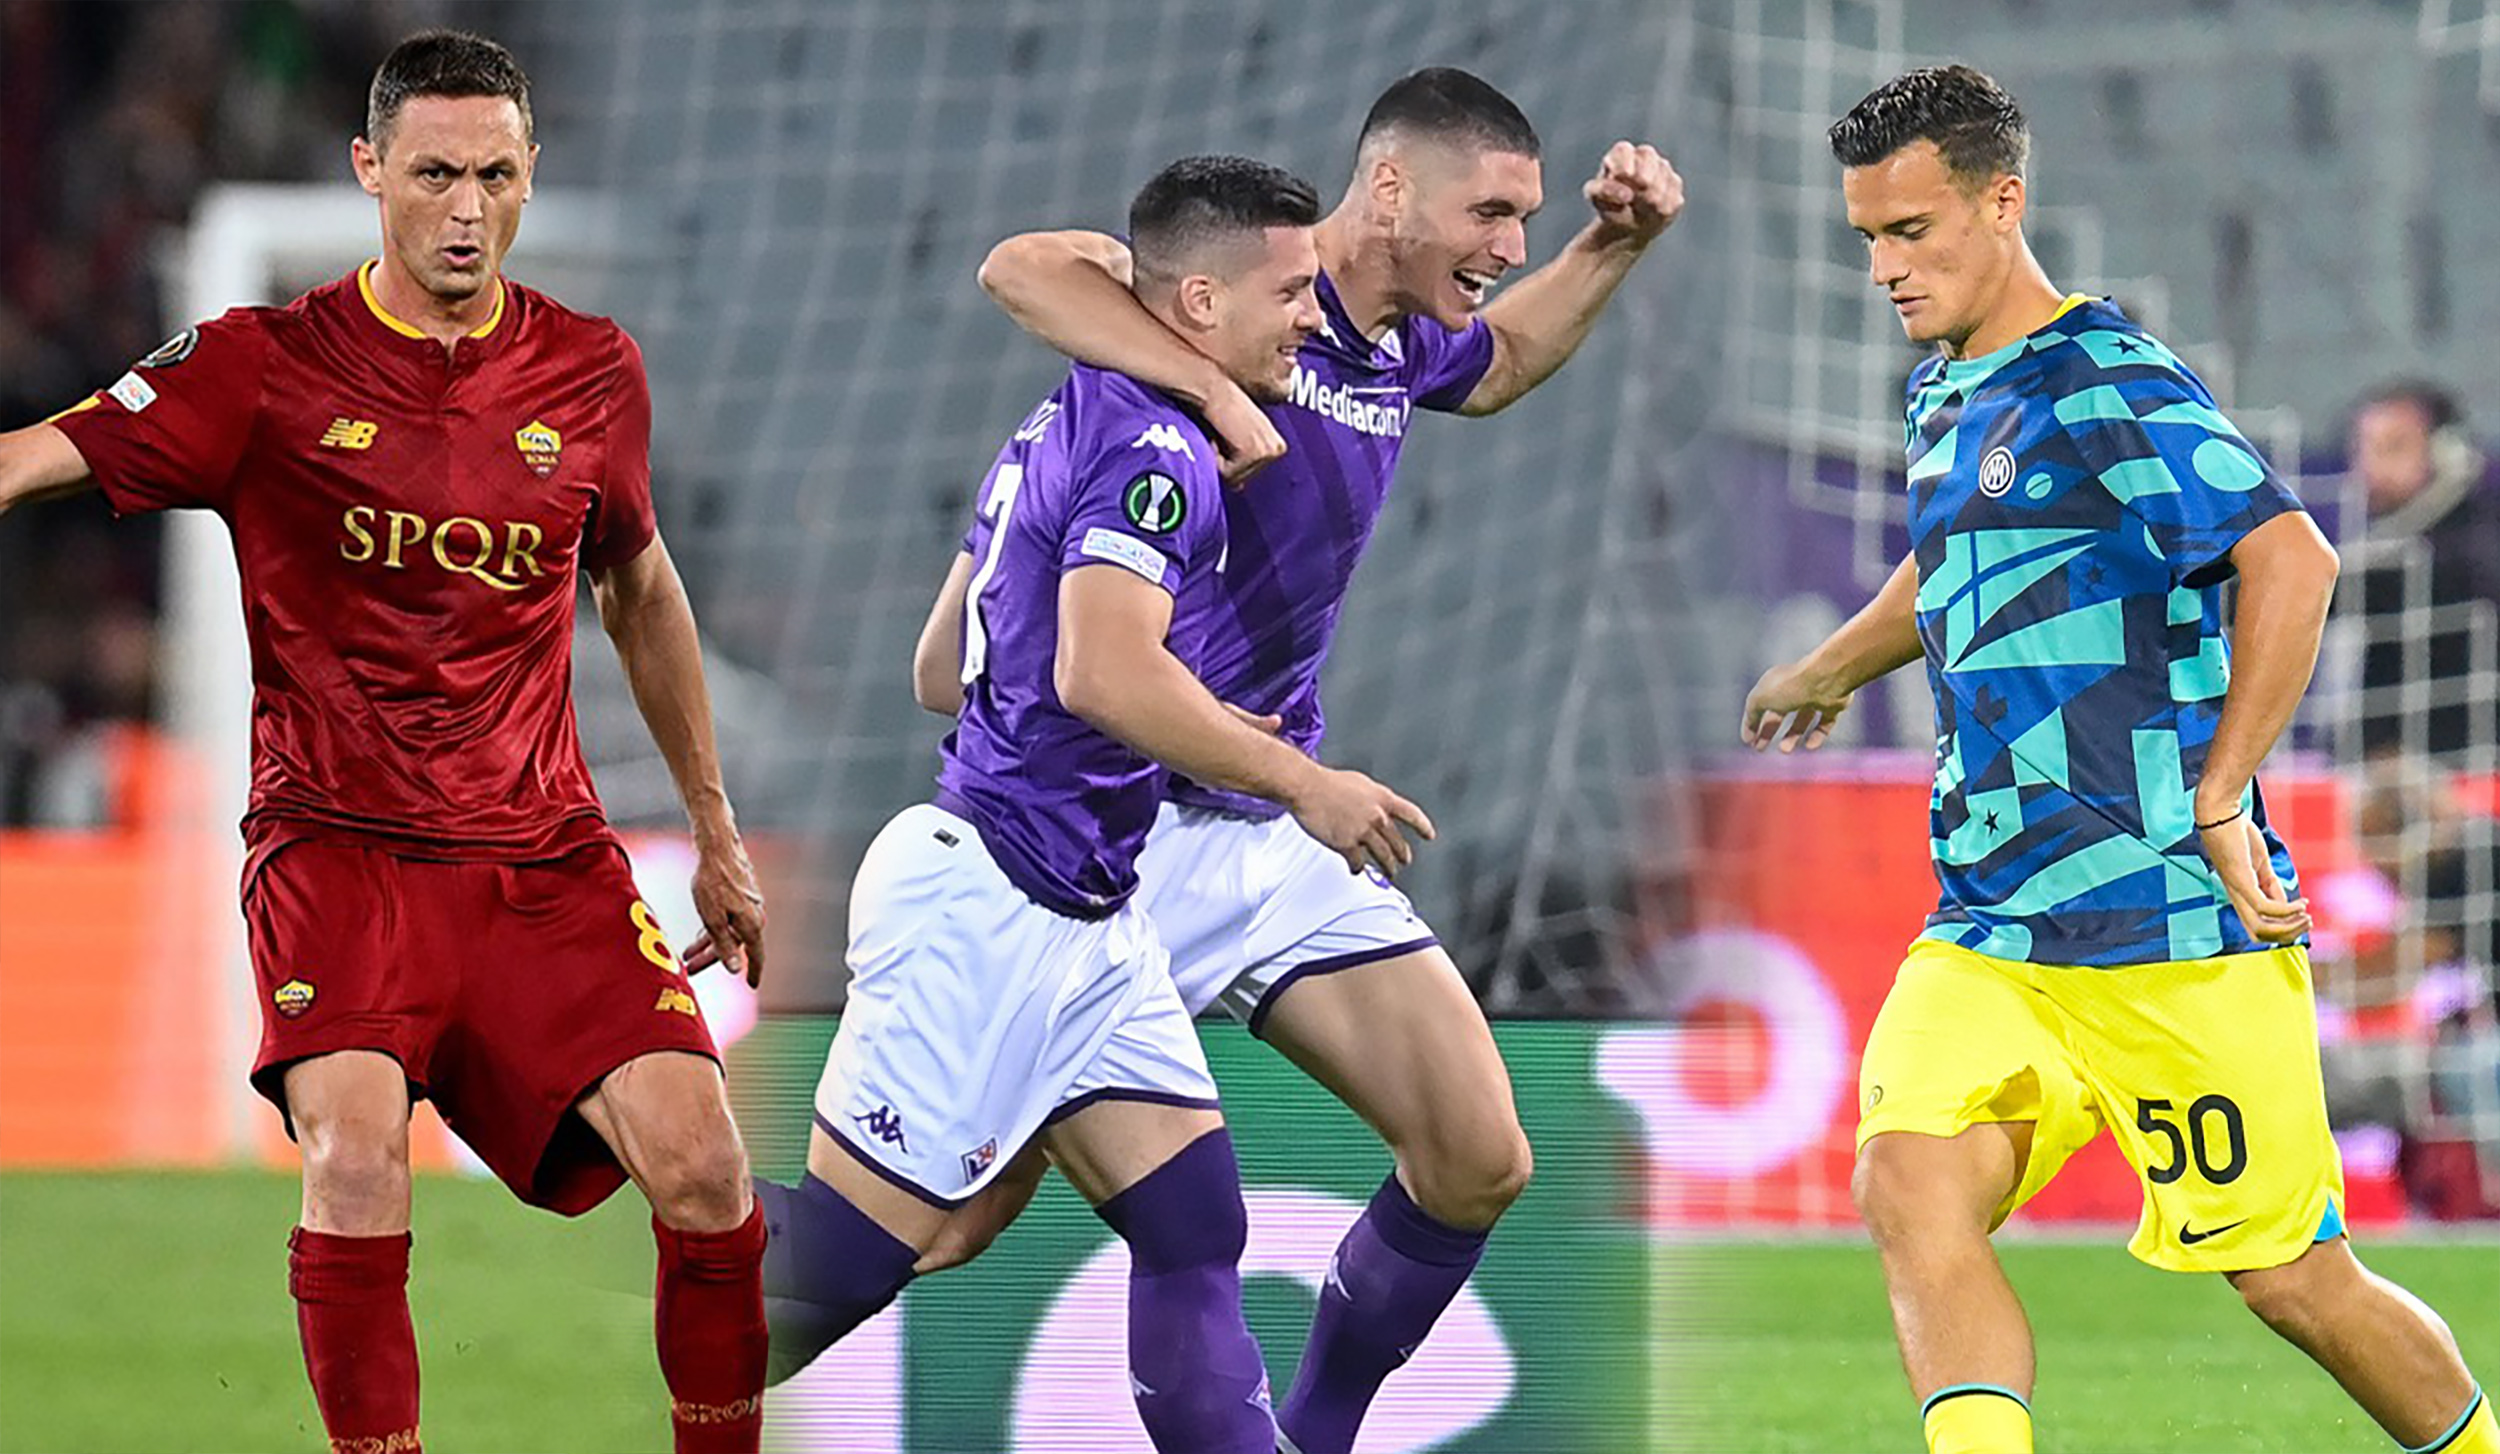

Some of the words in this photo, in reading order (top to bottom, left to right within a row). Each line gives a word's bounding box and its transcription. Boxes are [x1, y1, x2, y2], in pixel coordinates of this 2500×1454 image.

[340, 505, 546, 591] SPQR
[961, 464, 1023, 685] 7
[2136, 1094, 2248, 1186] 50
